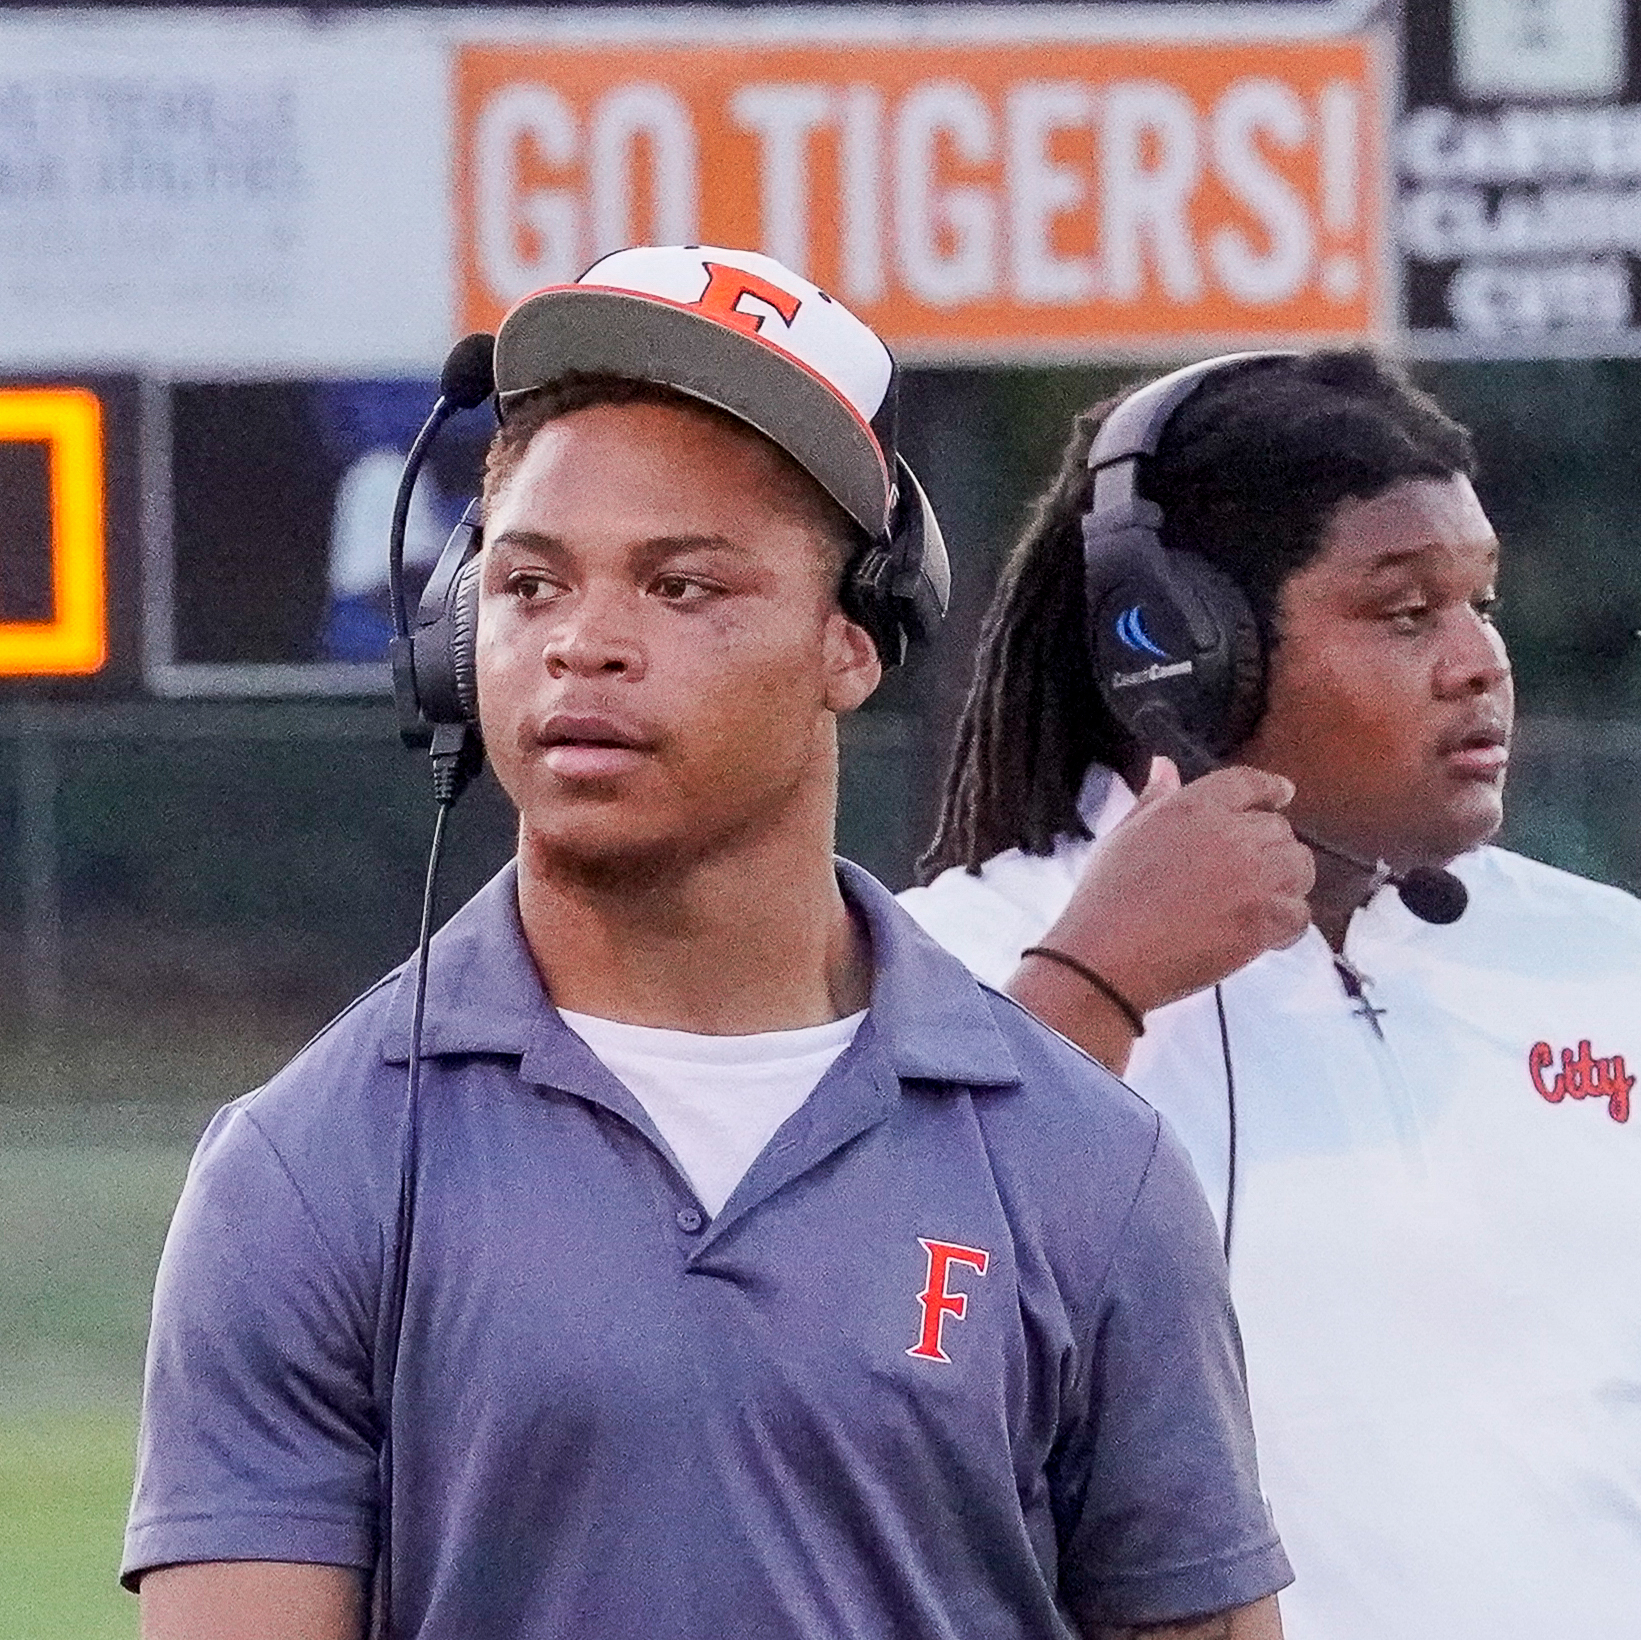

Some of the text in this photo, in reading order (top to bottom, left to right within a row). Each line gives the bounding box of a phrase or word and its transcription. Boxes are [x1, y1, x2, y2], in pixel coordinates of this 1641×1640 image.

[476, 78, 1358, 308] GO TIGERS!
[688, 262, 802, 333] F
[1529, 1039, 1636, 1124] City
[905, 1236, 990, 1364] F
